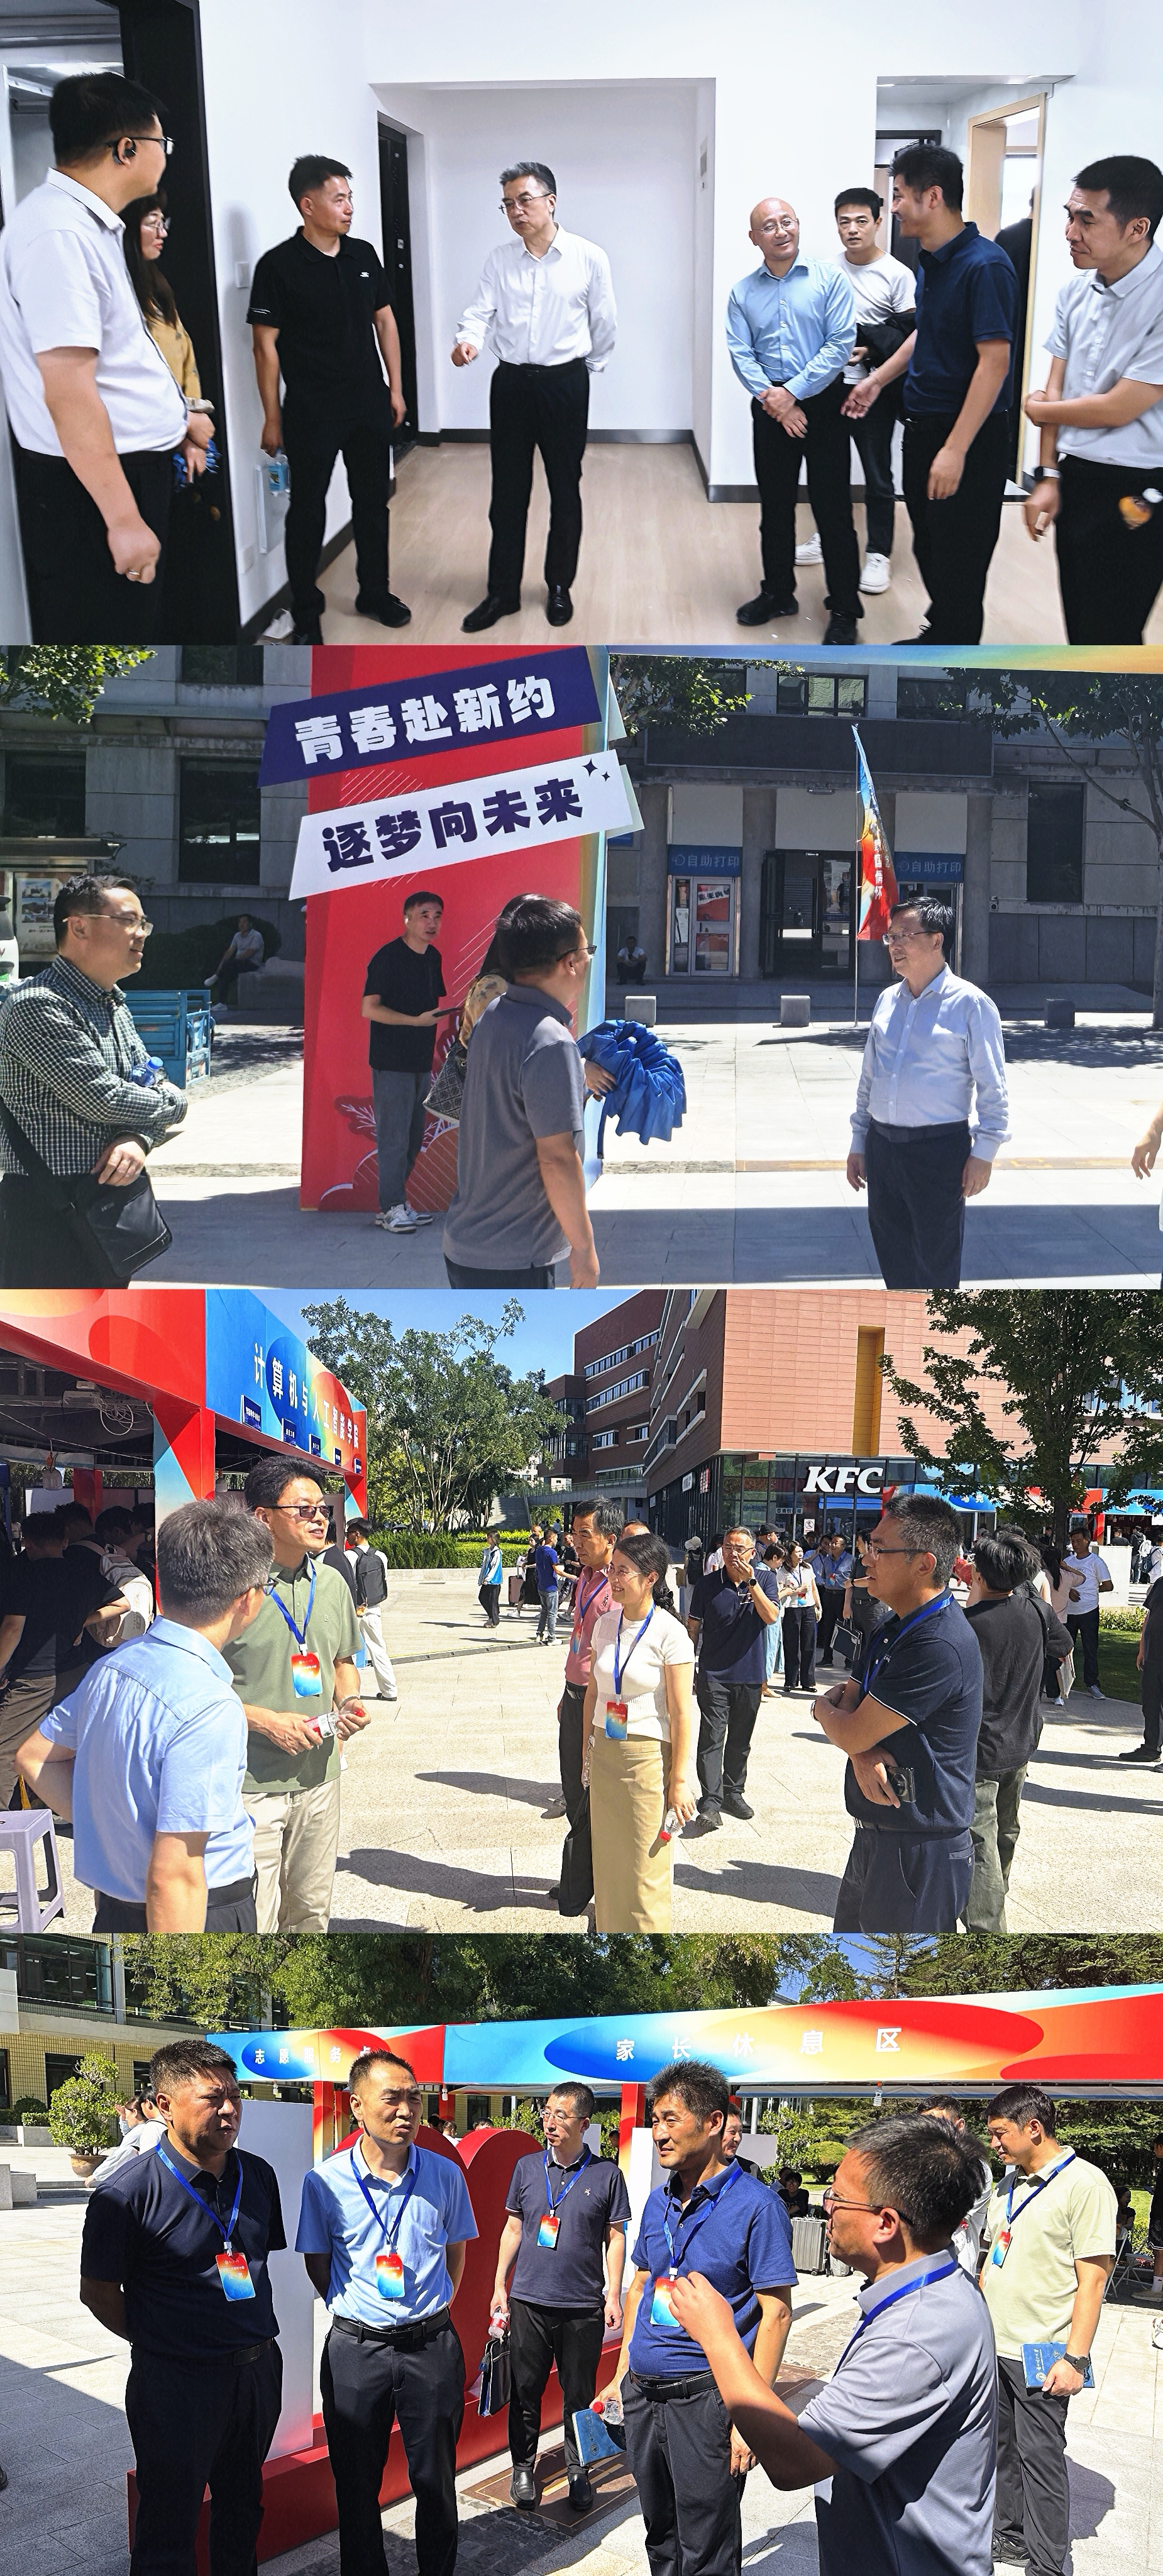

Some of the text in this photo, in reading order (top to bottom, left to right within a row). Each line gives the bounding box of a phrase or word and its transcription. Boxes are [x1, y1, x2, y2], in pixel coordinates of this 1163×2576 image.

[294, 675, 556, 764] 青春赴新约
[321, 777, 584, 873] 逐梦向未来
[687, 854, 739, 868] 自助打印
[911, 861, 961, 873] 自助打印
[254, 1341, 360, 1450] 计算机与人工智能学院
[803, 1466, 883, 1493] KFC
[615, 2027, 902, 2062] 家长休息区
